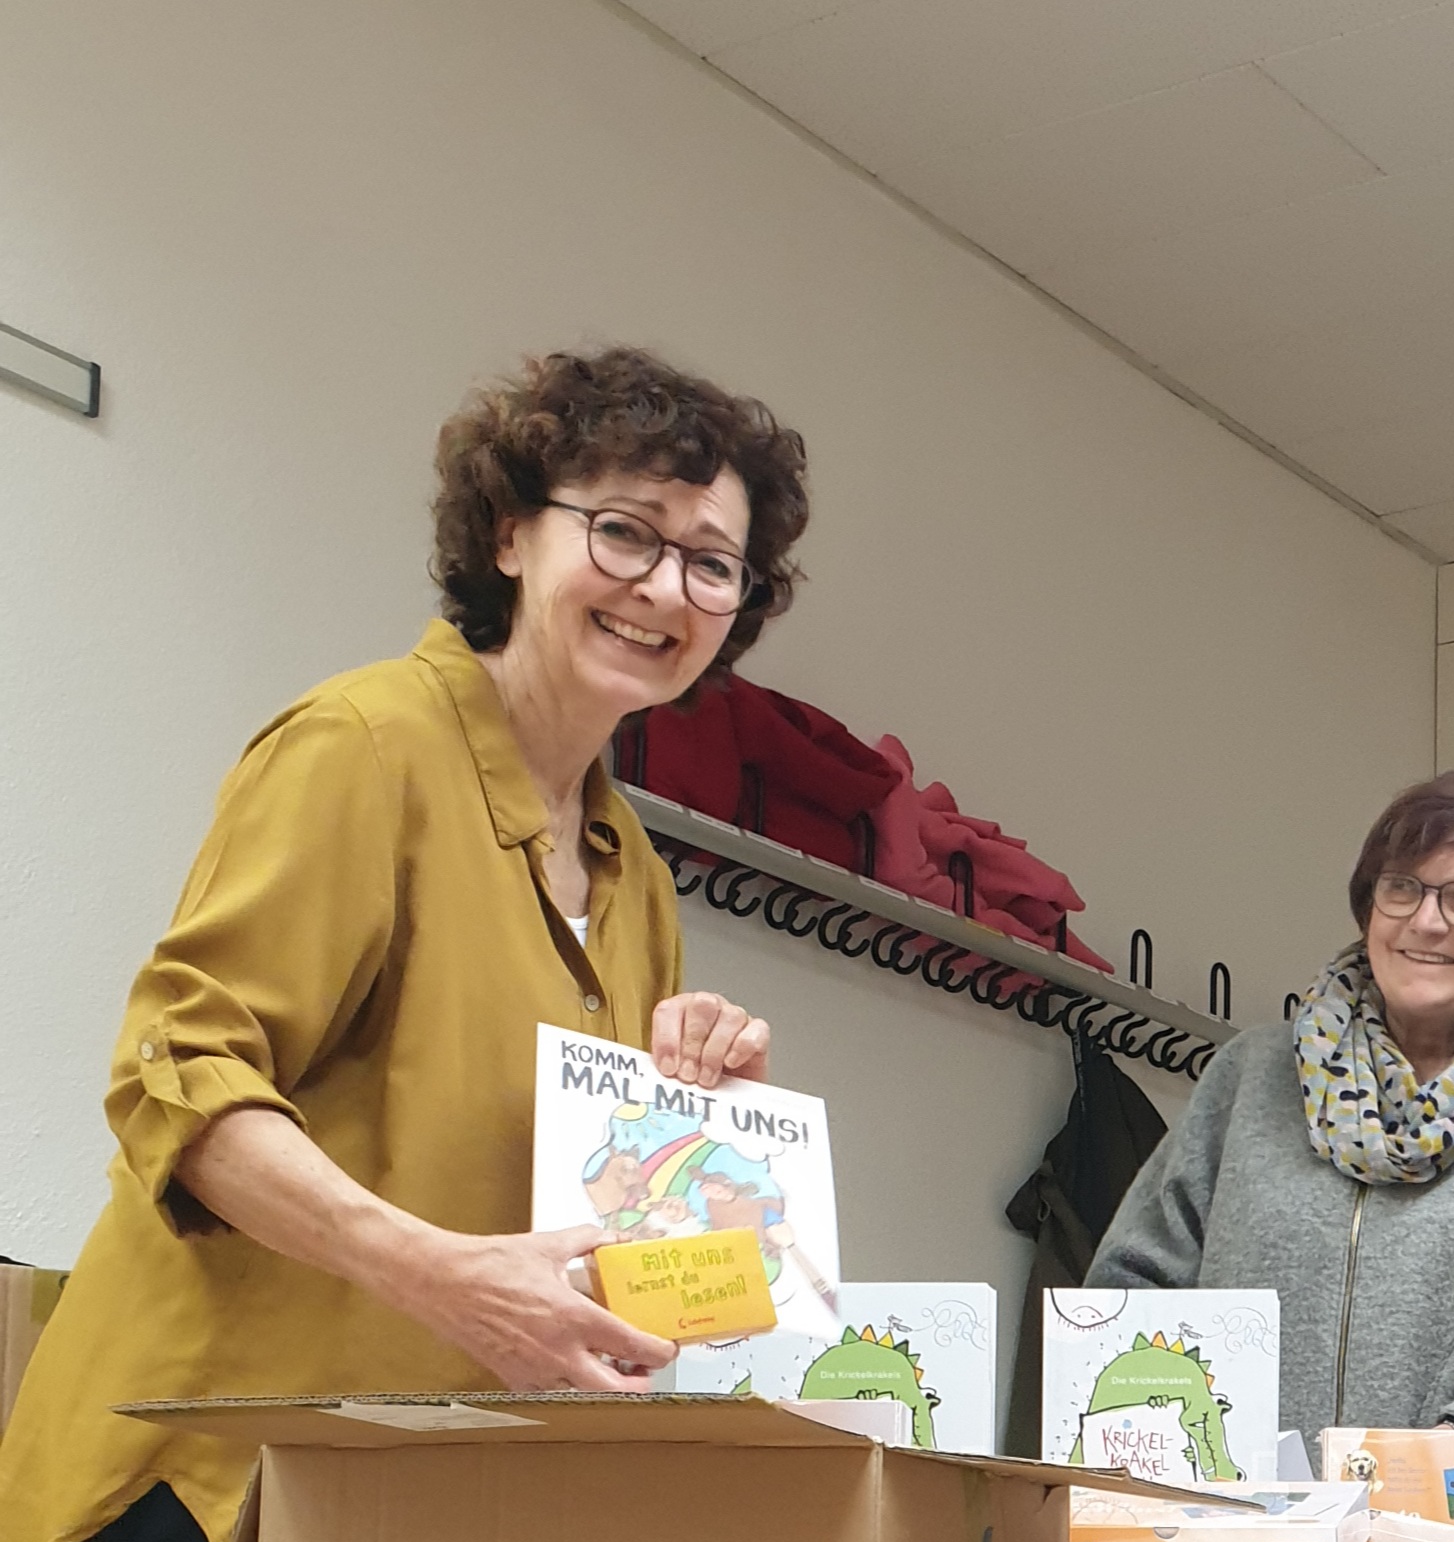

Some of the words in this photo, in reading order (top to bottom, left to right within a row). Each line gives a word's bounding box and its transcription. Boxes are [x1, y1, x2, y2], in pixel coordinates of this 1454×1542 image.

[561, 1041, 644, 1078] KOMM,
[561, 1062, 641, 1106] MAL
[731, 1105, 809, 1149] UNS!
[820, 1371, 835, 1379] Die
[1111, 1377, 1126, 1385] Die
[1102, 1425, 1174, 1456] KRICKEL-
